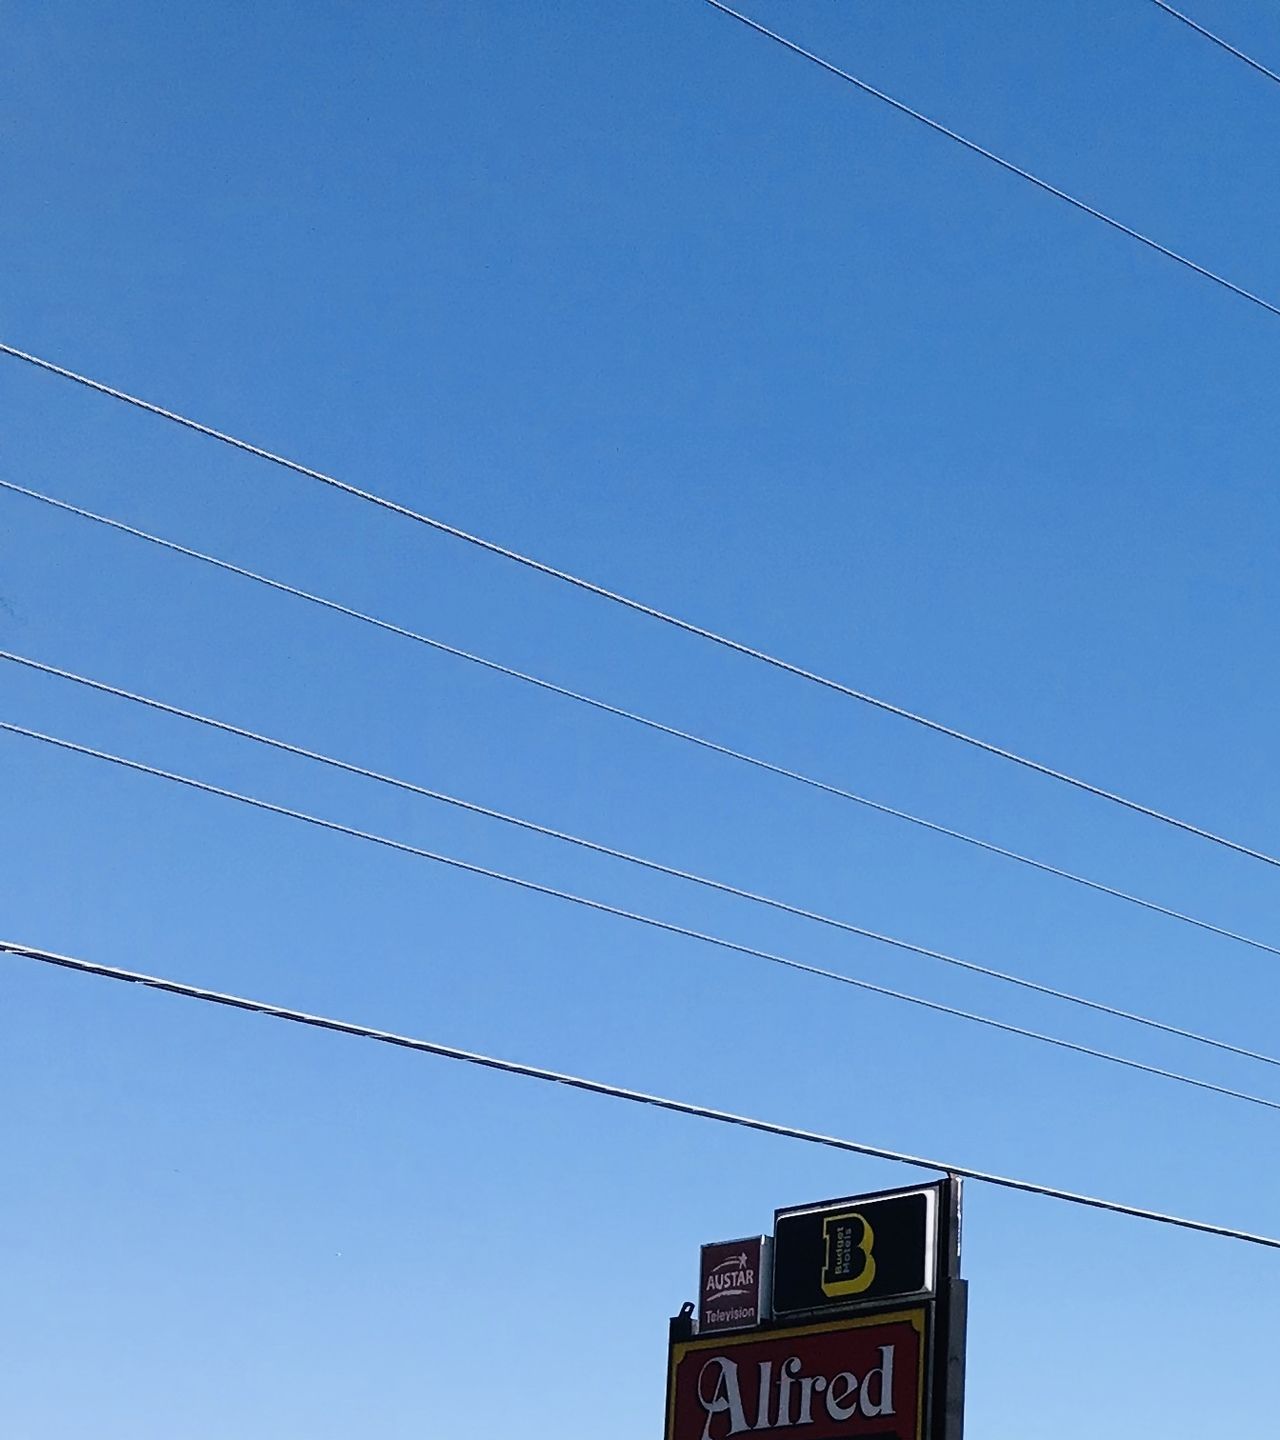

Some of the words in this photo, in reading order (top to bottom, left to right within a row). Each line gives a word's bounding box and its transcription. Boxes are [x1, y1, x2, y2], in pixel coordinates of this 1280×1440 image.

[835, 1226, 844, 1275] Budget
[842, 1227, 852, 1274] Motels
[706, 1269, 754, 1292] AUSTAR
[705, 1306, 755, 1324] Television
